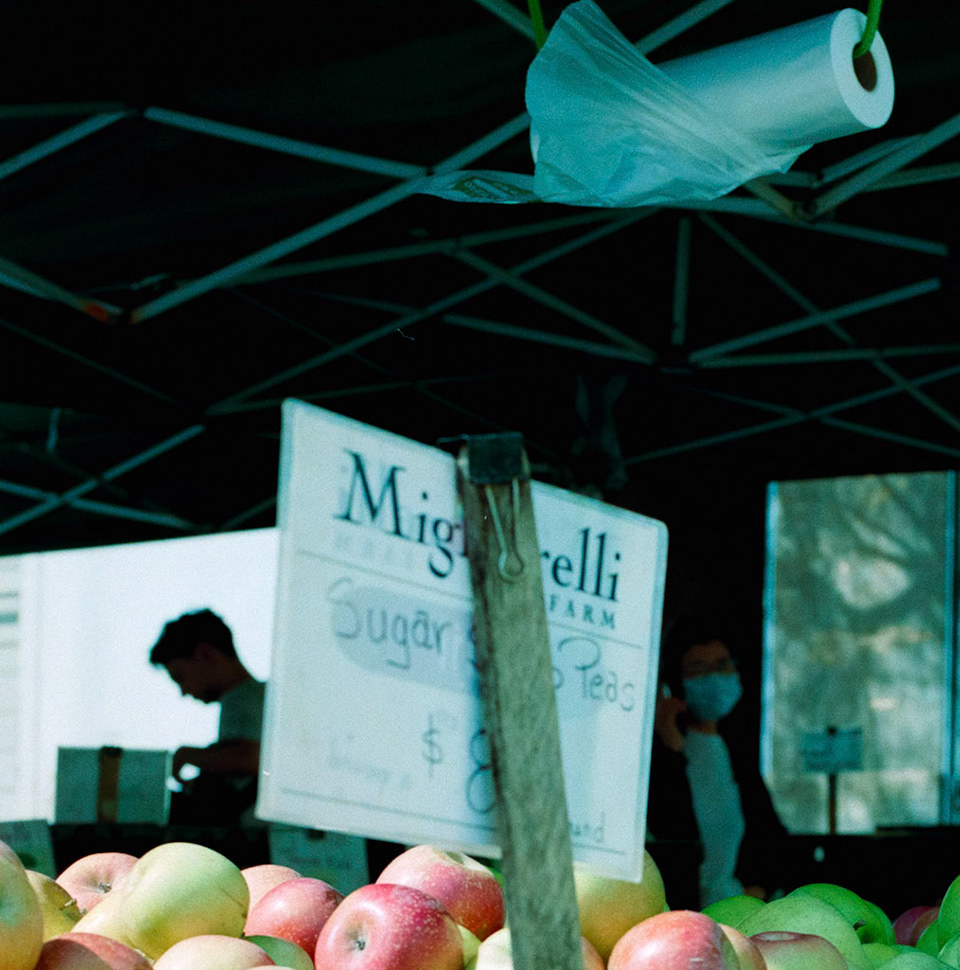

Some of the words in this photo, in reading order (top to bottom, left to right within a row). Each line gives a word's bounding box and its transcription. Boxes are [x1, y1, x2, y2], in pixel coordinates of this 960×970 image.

[334, 449, 619, 602] Migelli
[328, 577, 451, 671] Sugar
[557, 635, 636, 712] Peas
[550, 593, 616, 630] FARM
